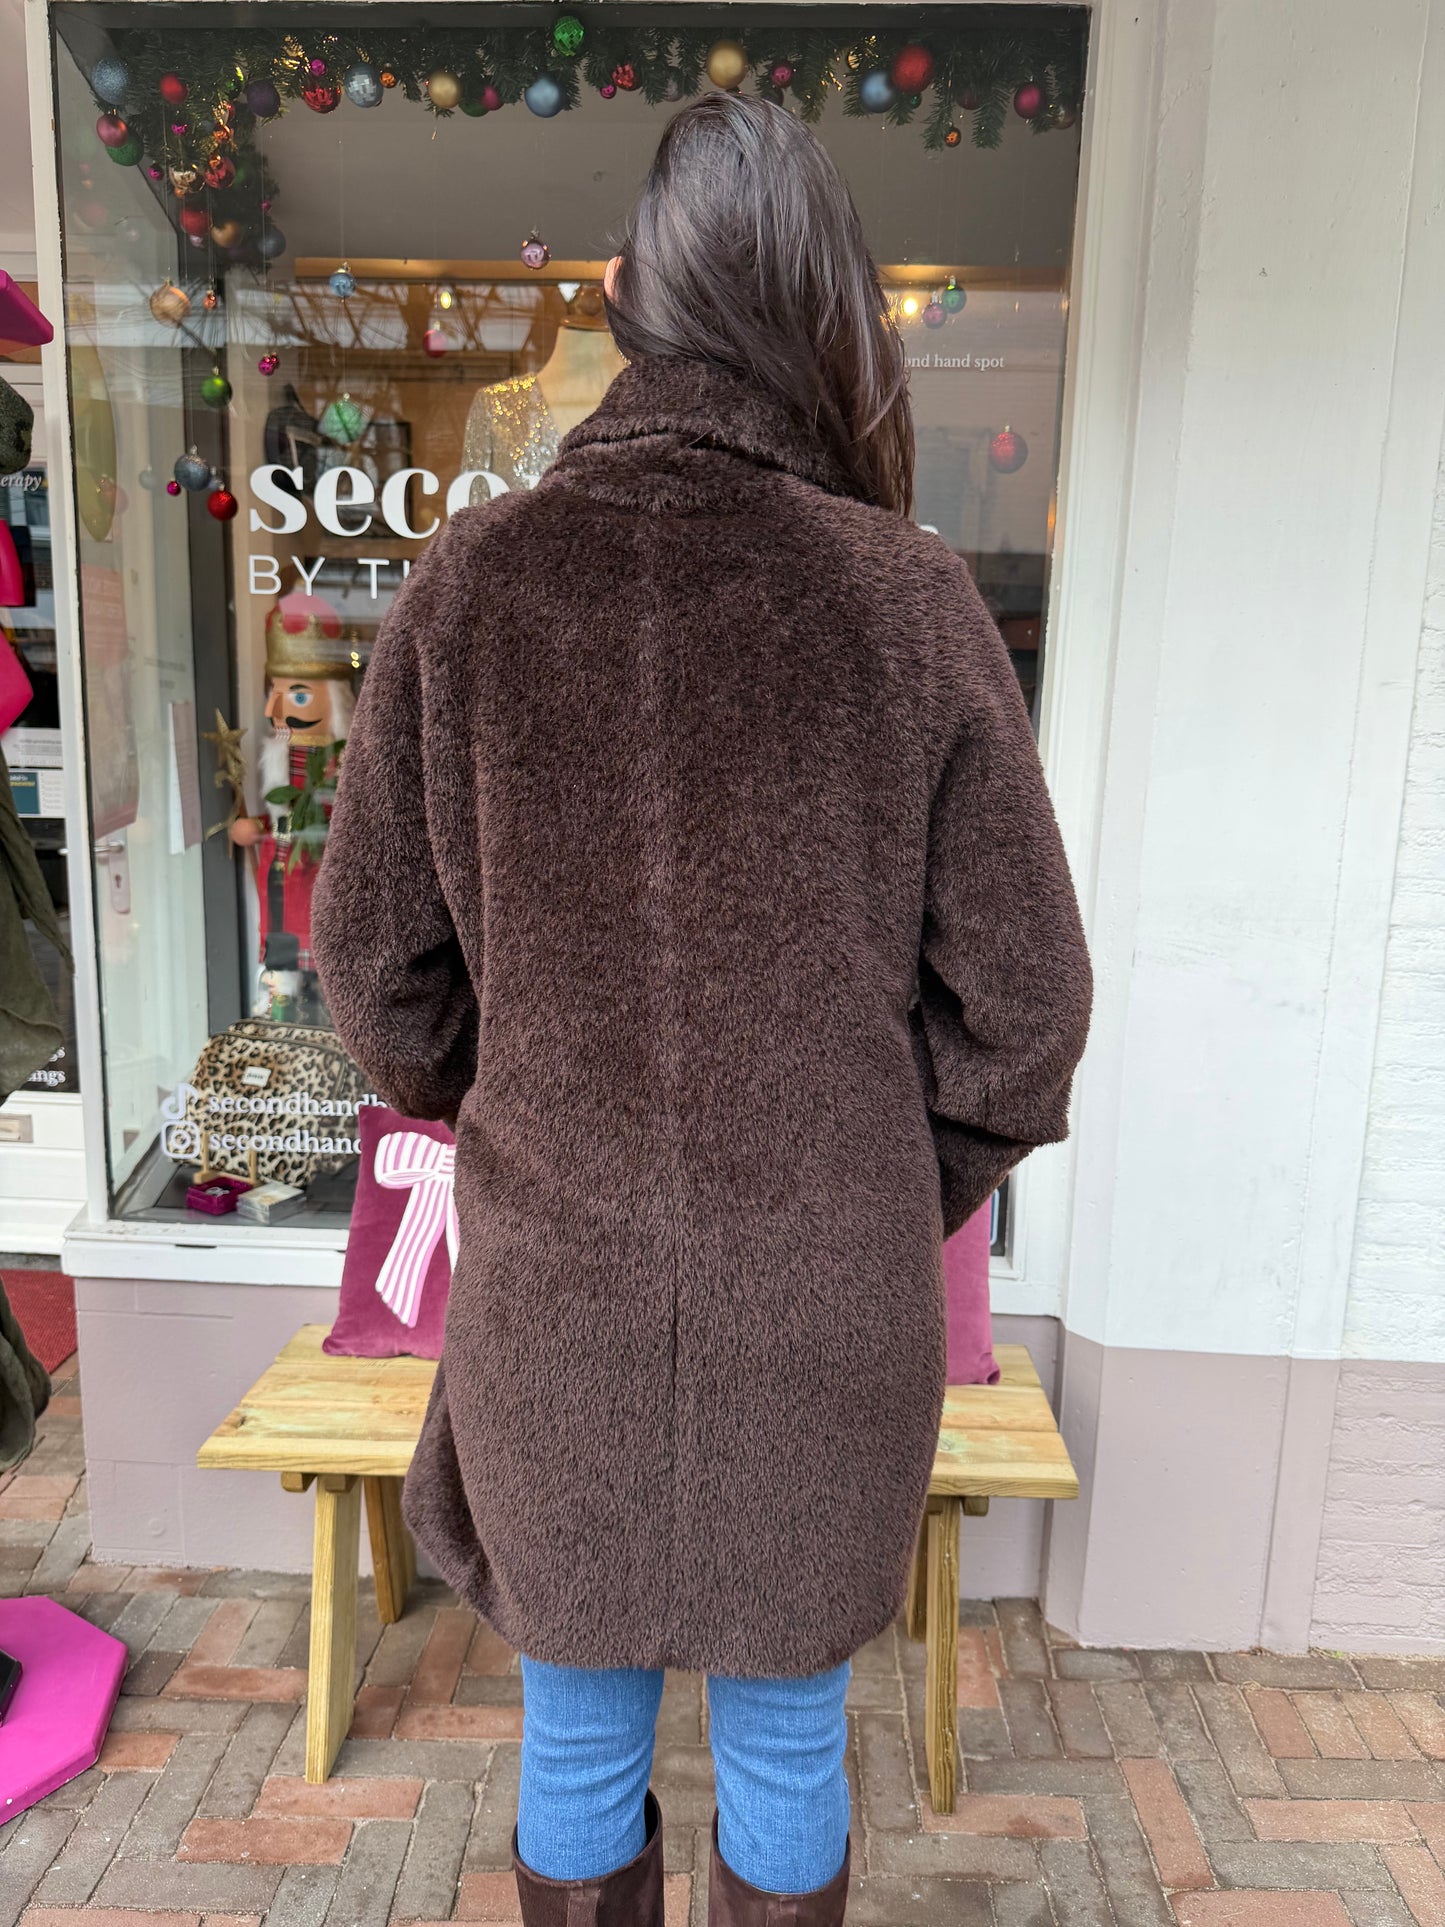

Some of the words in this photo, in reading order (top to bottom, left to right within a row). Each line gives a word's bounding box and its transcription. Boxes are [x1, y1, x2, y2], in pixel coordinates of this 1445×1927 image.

[934, 354, 971, 368] hand
[974, 356, 1005, 371] spot
[248, 554, 326, 597] BY
